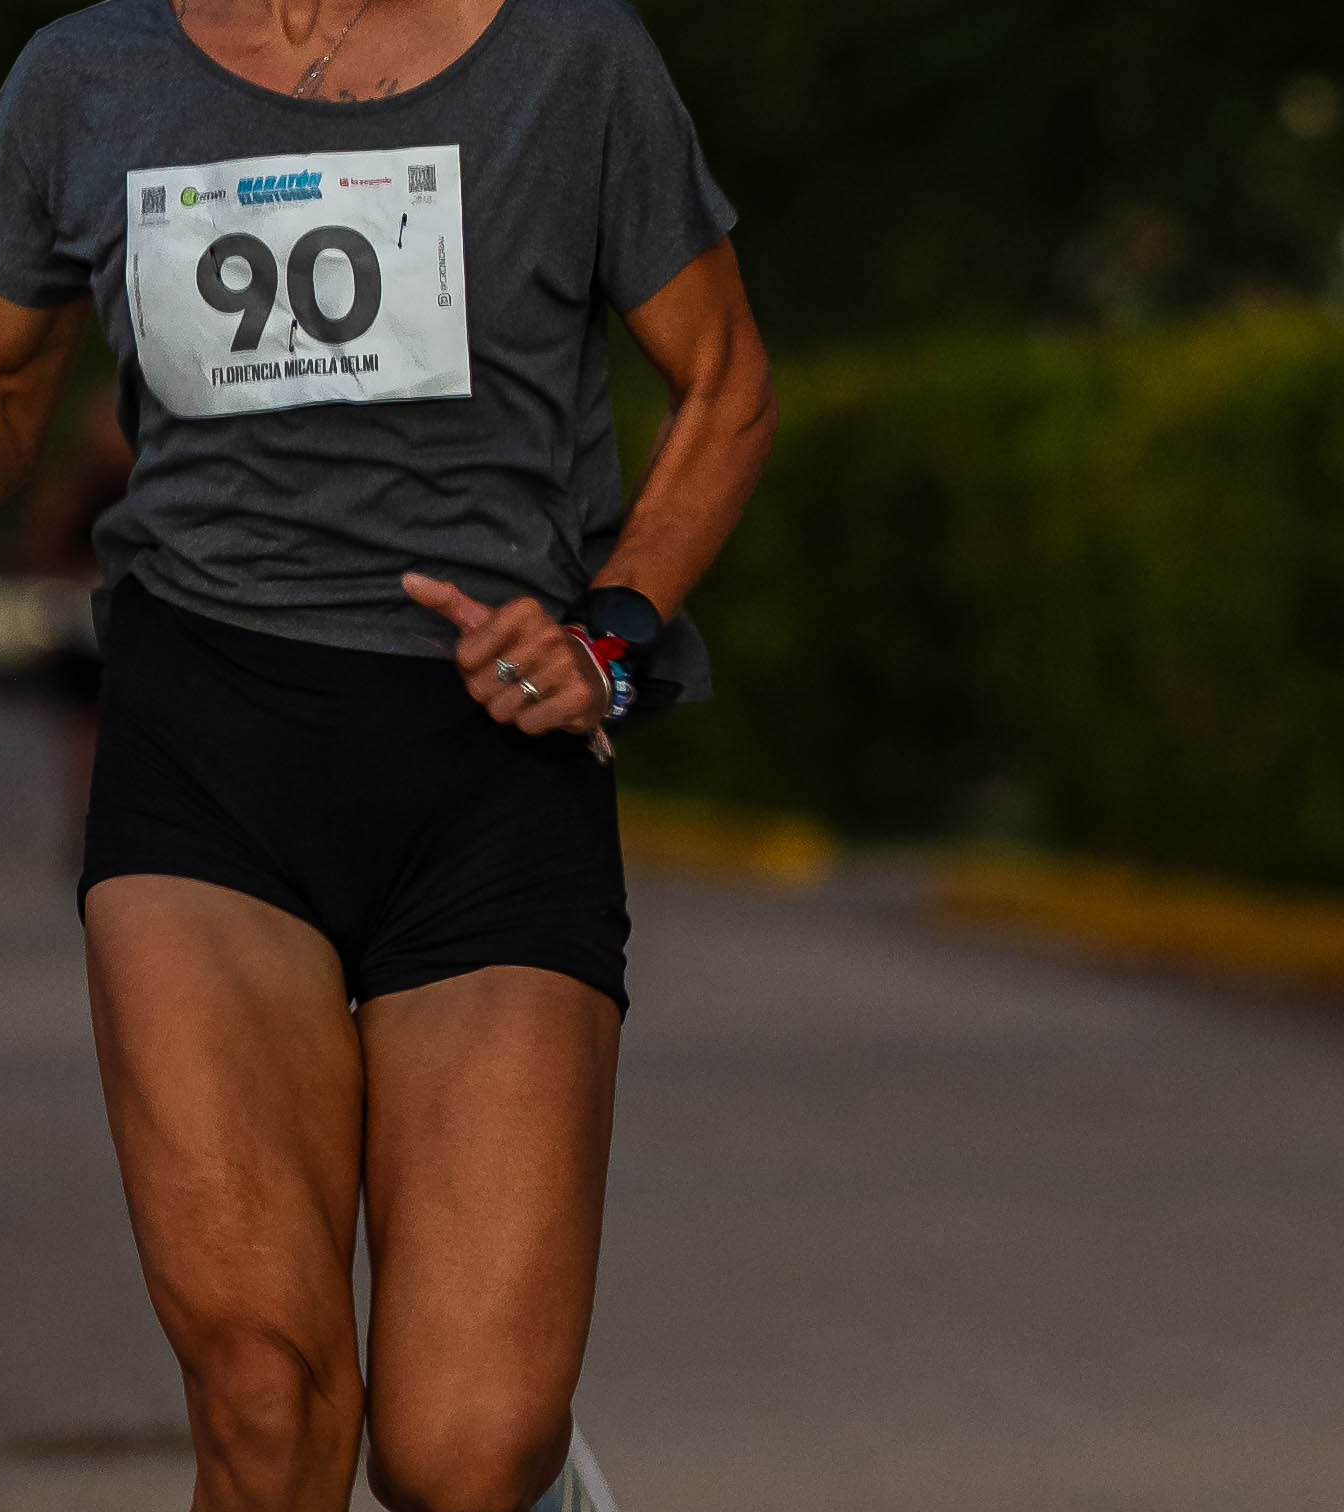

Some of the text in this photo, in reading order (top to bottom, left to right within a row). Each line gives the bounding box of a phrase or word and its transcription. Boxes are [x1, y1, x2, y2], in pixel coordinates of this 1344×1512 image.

[196, 225, 382, 353] 90
[212, 362, 282, 385] FLORENCIA
[284, 356, 338, 379] MICAELA
